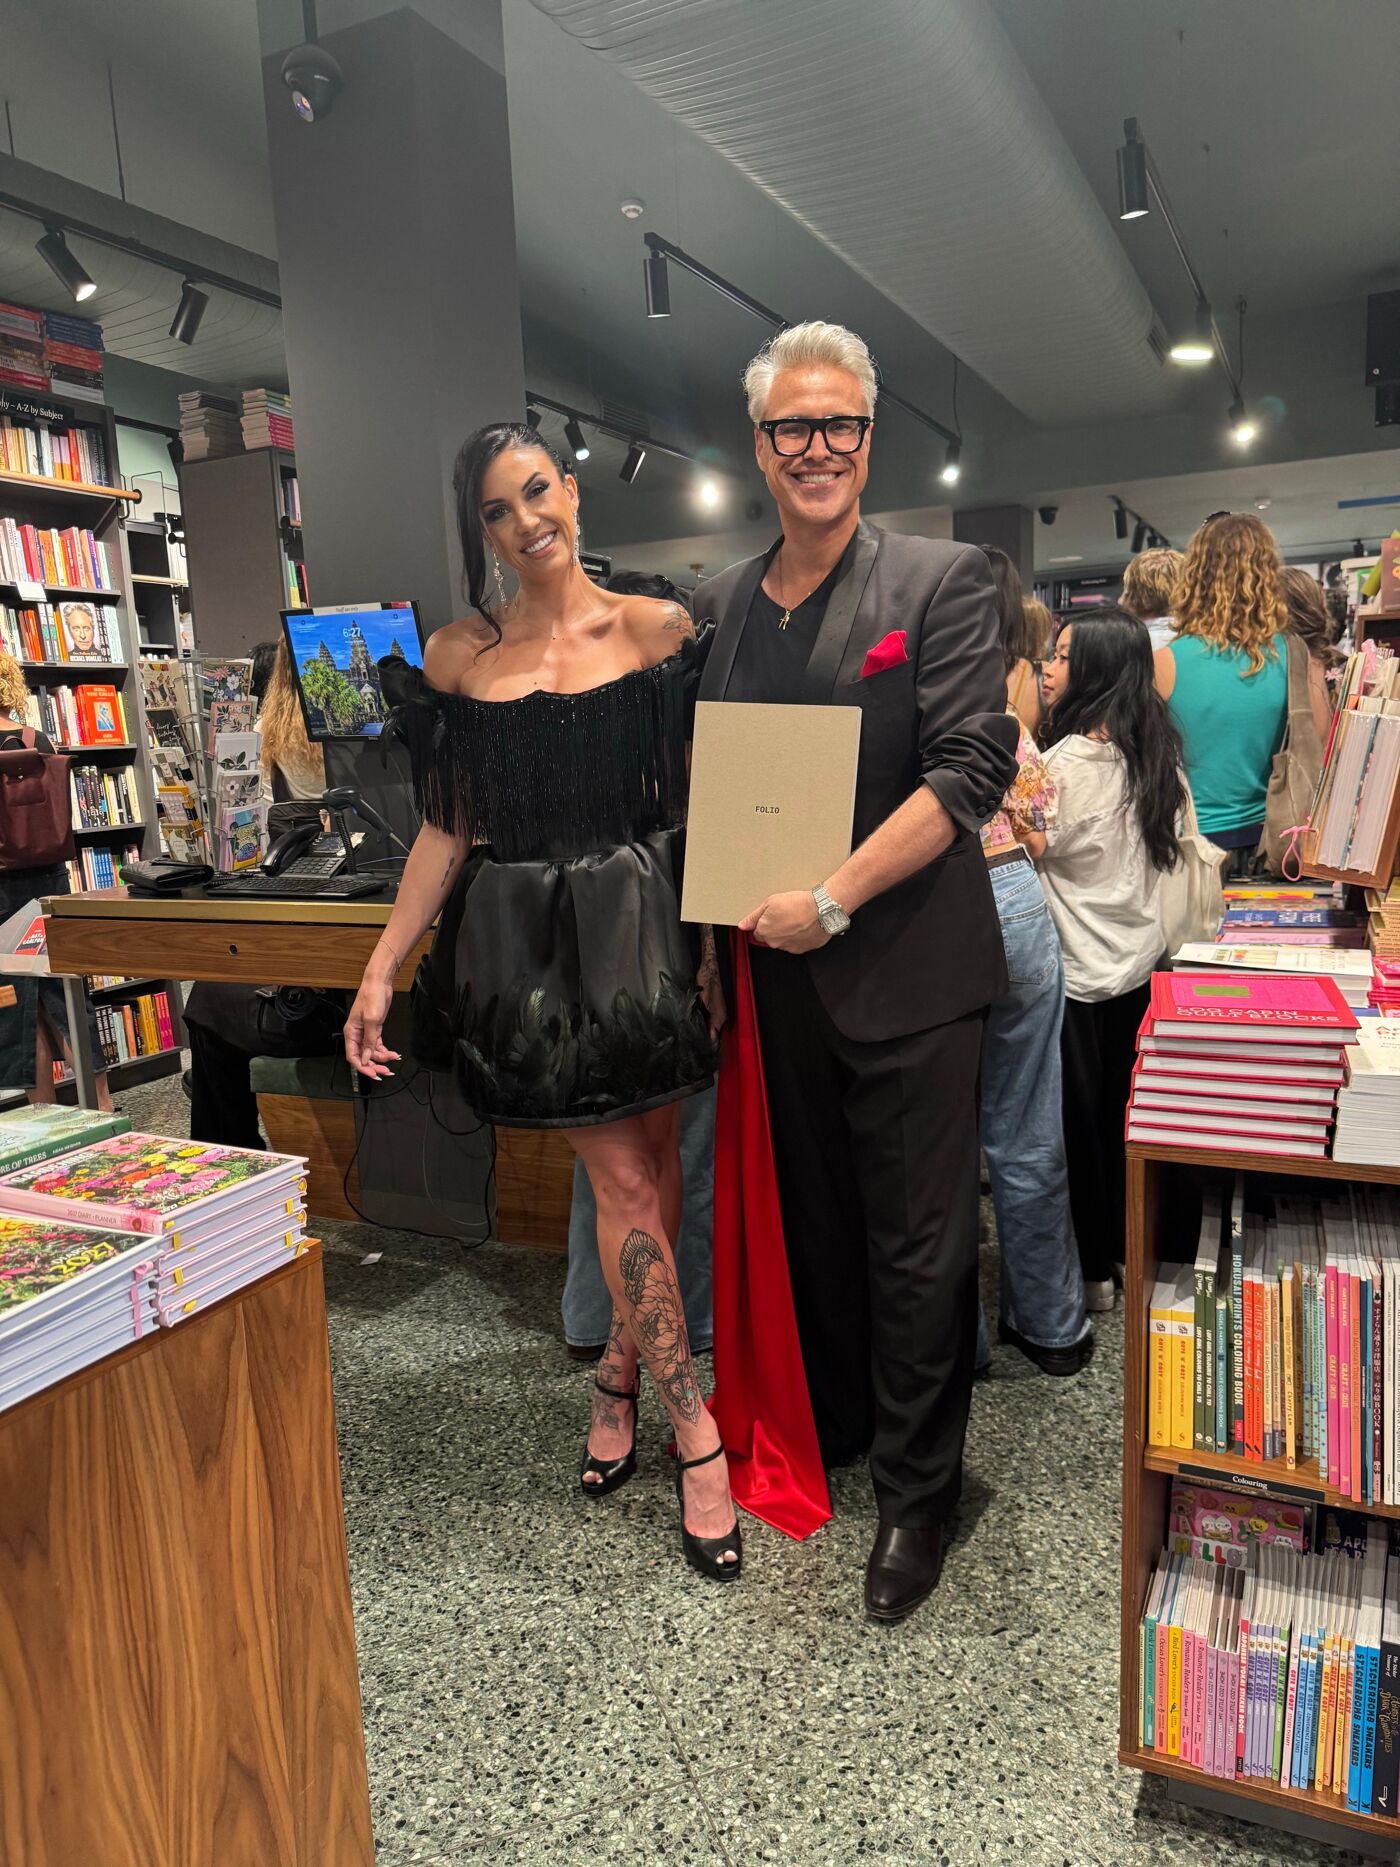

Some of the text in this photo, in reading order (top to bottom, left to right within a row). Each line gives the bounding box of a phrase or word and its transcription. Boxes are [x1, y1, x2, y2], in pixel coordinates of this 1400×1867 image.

[31, 405, 39, 416] by
[40, 408, 64, 420] Subject
[343, 628, 361, 638] 6:27
[755, 806, 780, 814] FOLIO
[1248, 1013, 1341, 1022] BLOCKS
[12, 1160, 22, 1168] OF
[22, 1152, 47, 1166] TREES
[78, 1210, 92, 1219] DIARY
[95, 1215, 117, 1224] PLANNER
[49, 1241, 114, 1275] 2027
[1244, 1301, 1252, 1324] LITTLE
[1233, 1254, 1244, 1405] HOKUSAI PRINTS COLORING BOOK
[1232, 1475, 1268, 1490] Colouring
[1351, 1653, 1365, 1767] STICKERBOMB SNEAKERS
[1364, 1656, 1378, 1770] STICKERBOMB SNEAKERS
